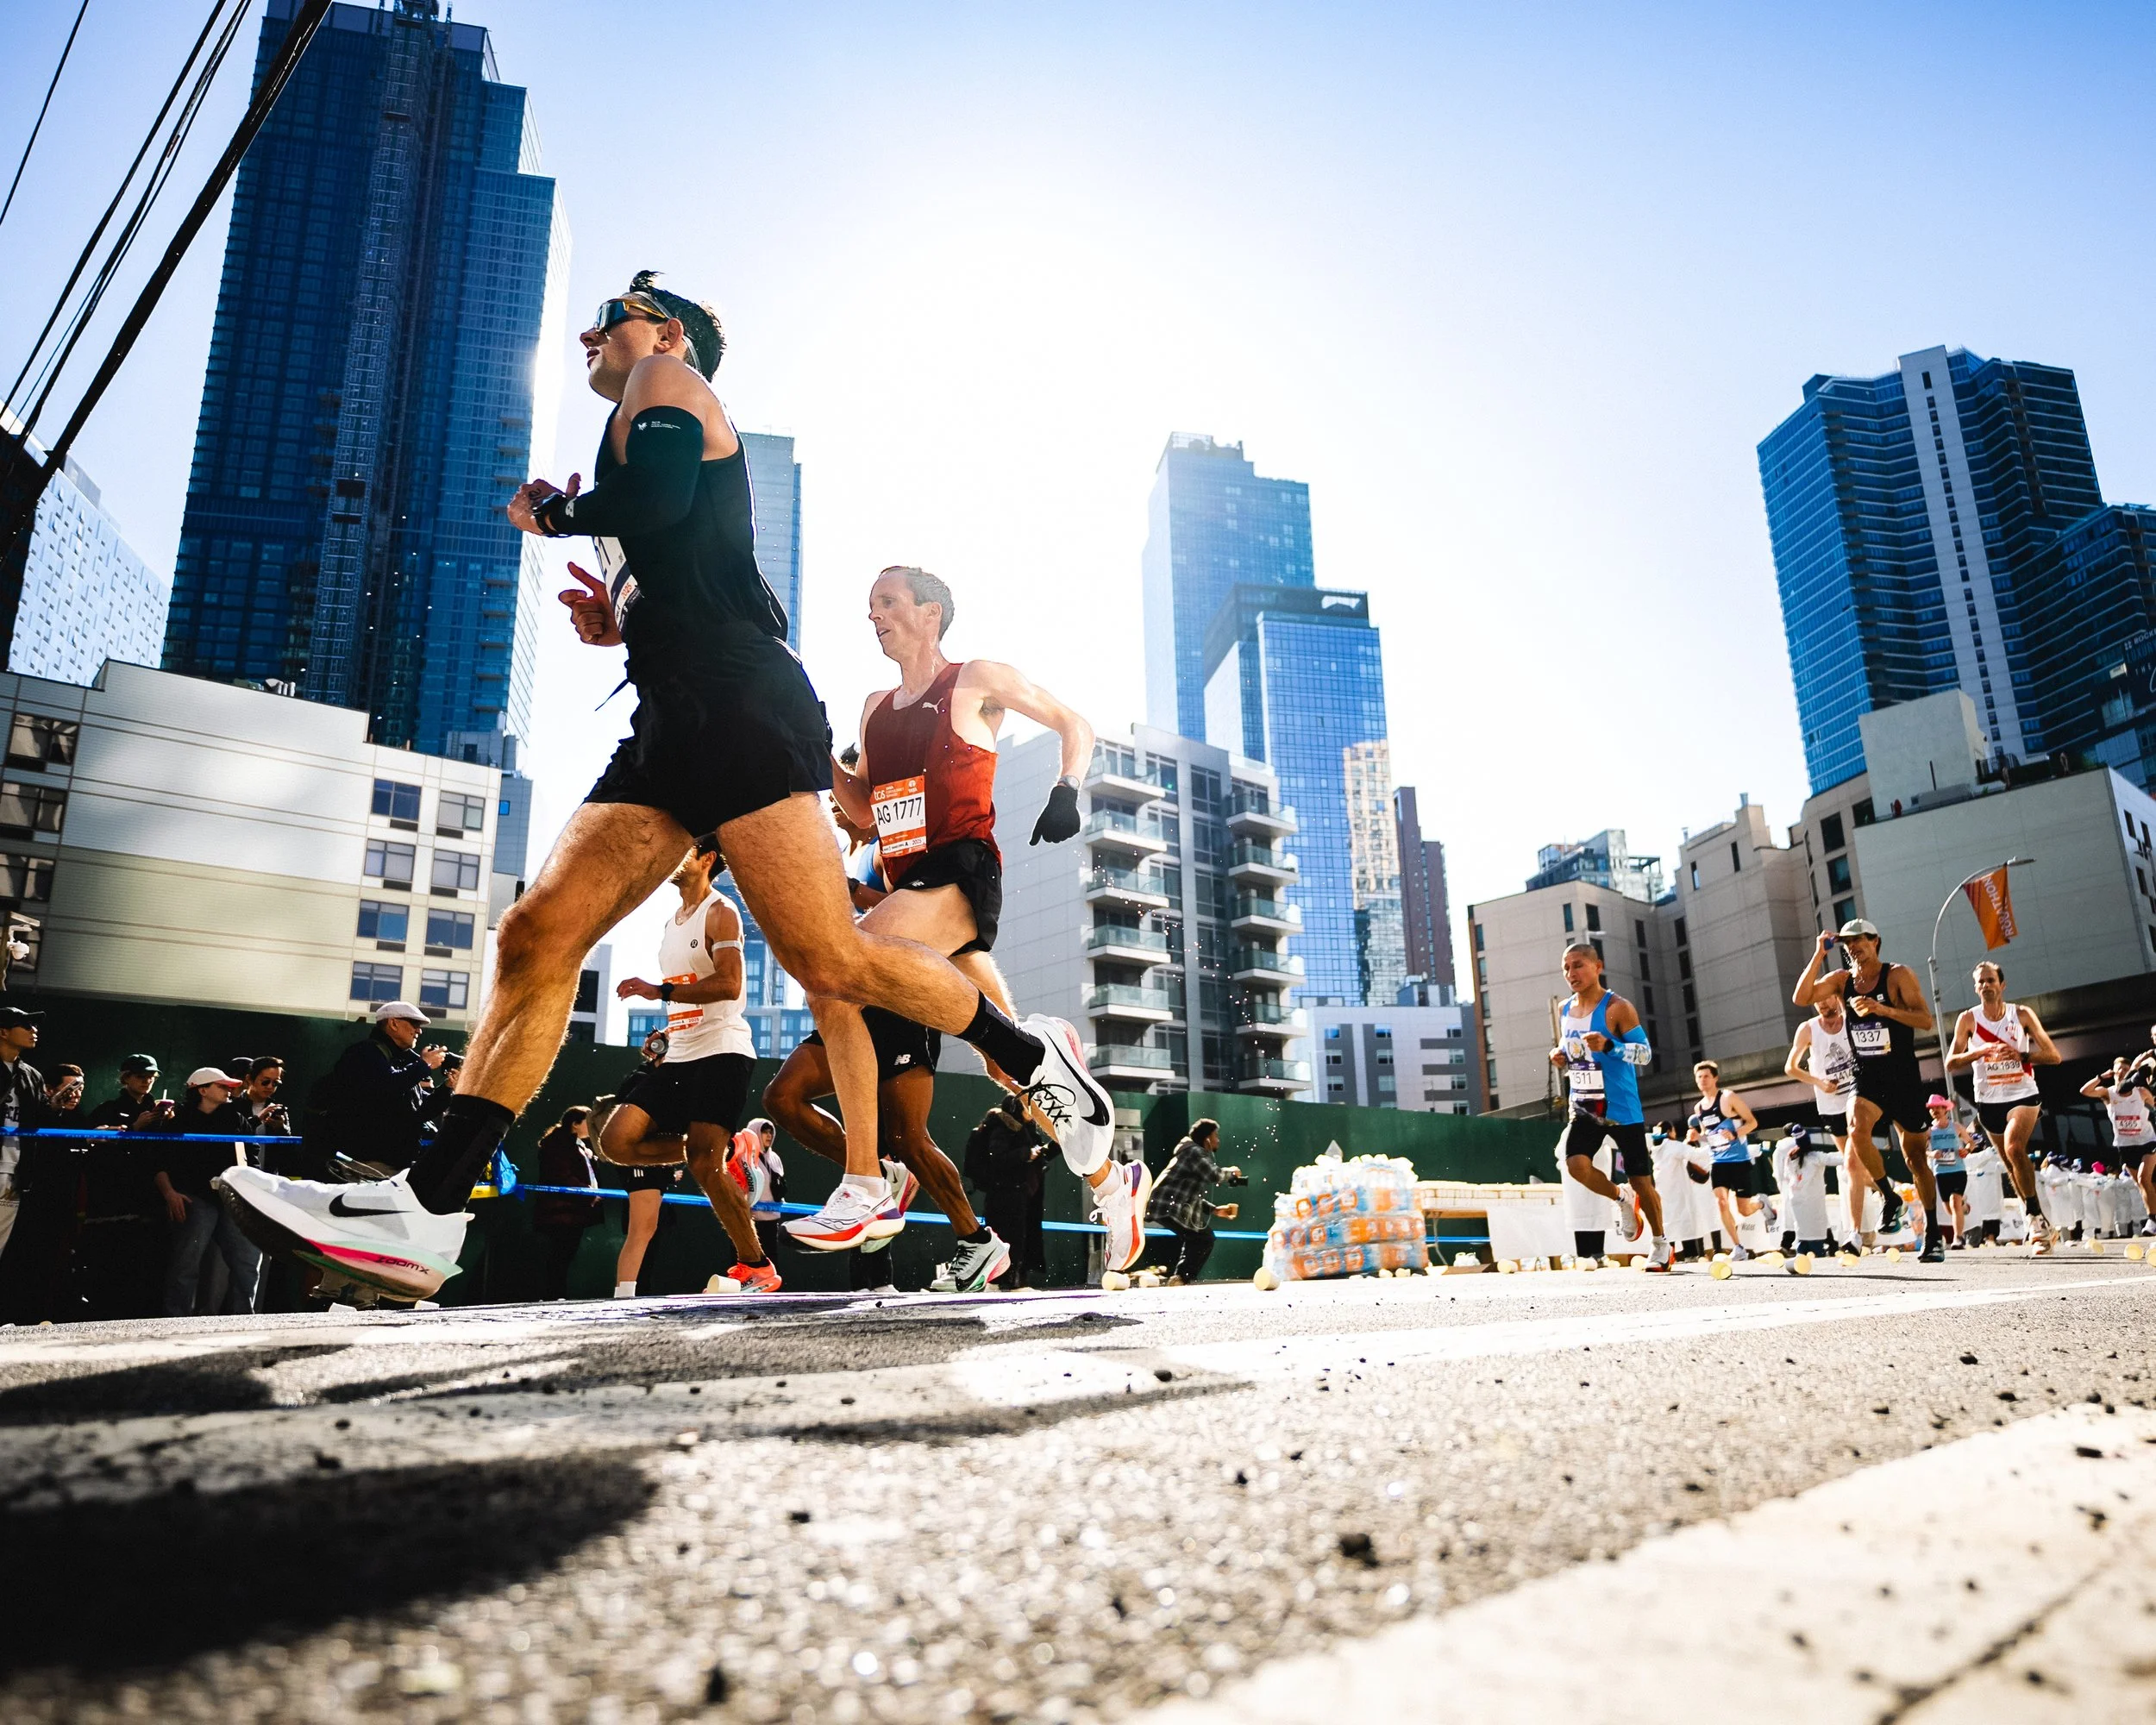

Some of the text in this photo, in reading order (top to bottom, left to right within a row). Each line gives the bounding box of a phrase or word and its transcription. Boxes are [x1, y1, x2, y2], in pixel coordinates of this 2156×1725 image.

[876, 796, 922, 825] AG 1777
[1855, 1031, 1881, 1044] 1337
[1987, 1063, 1999, 1072] AG
[742, 1160, 755, 1193] BROOKS
